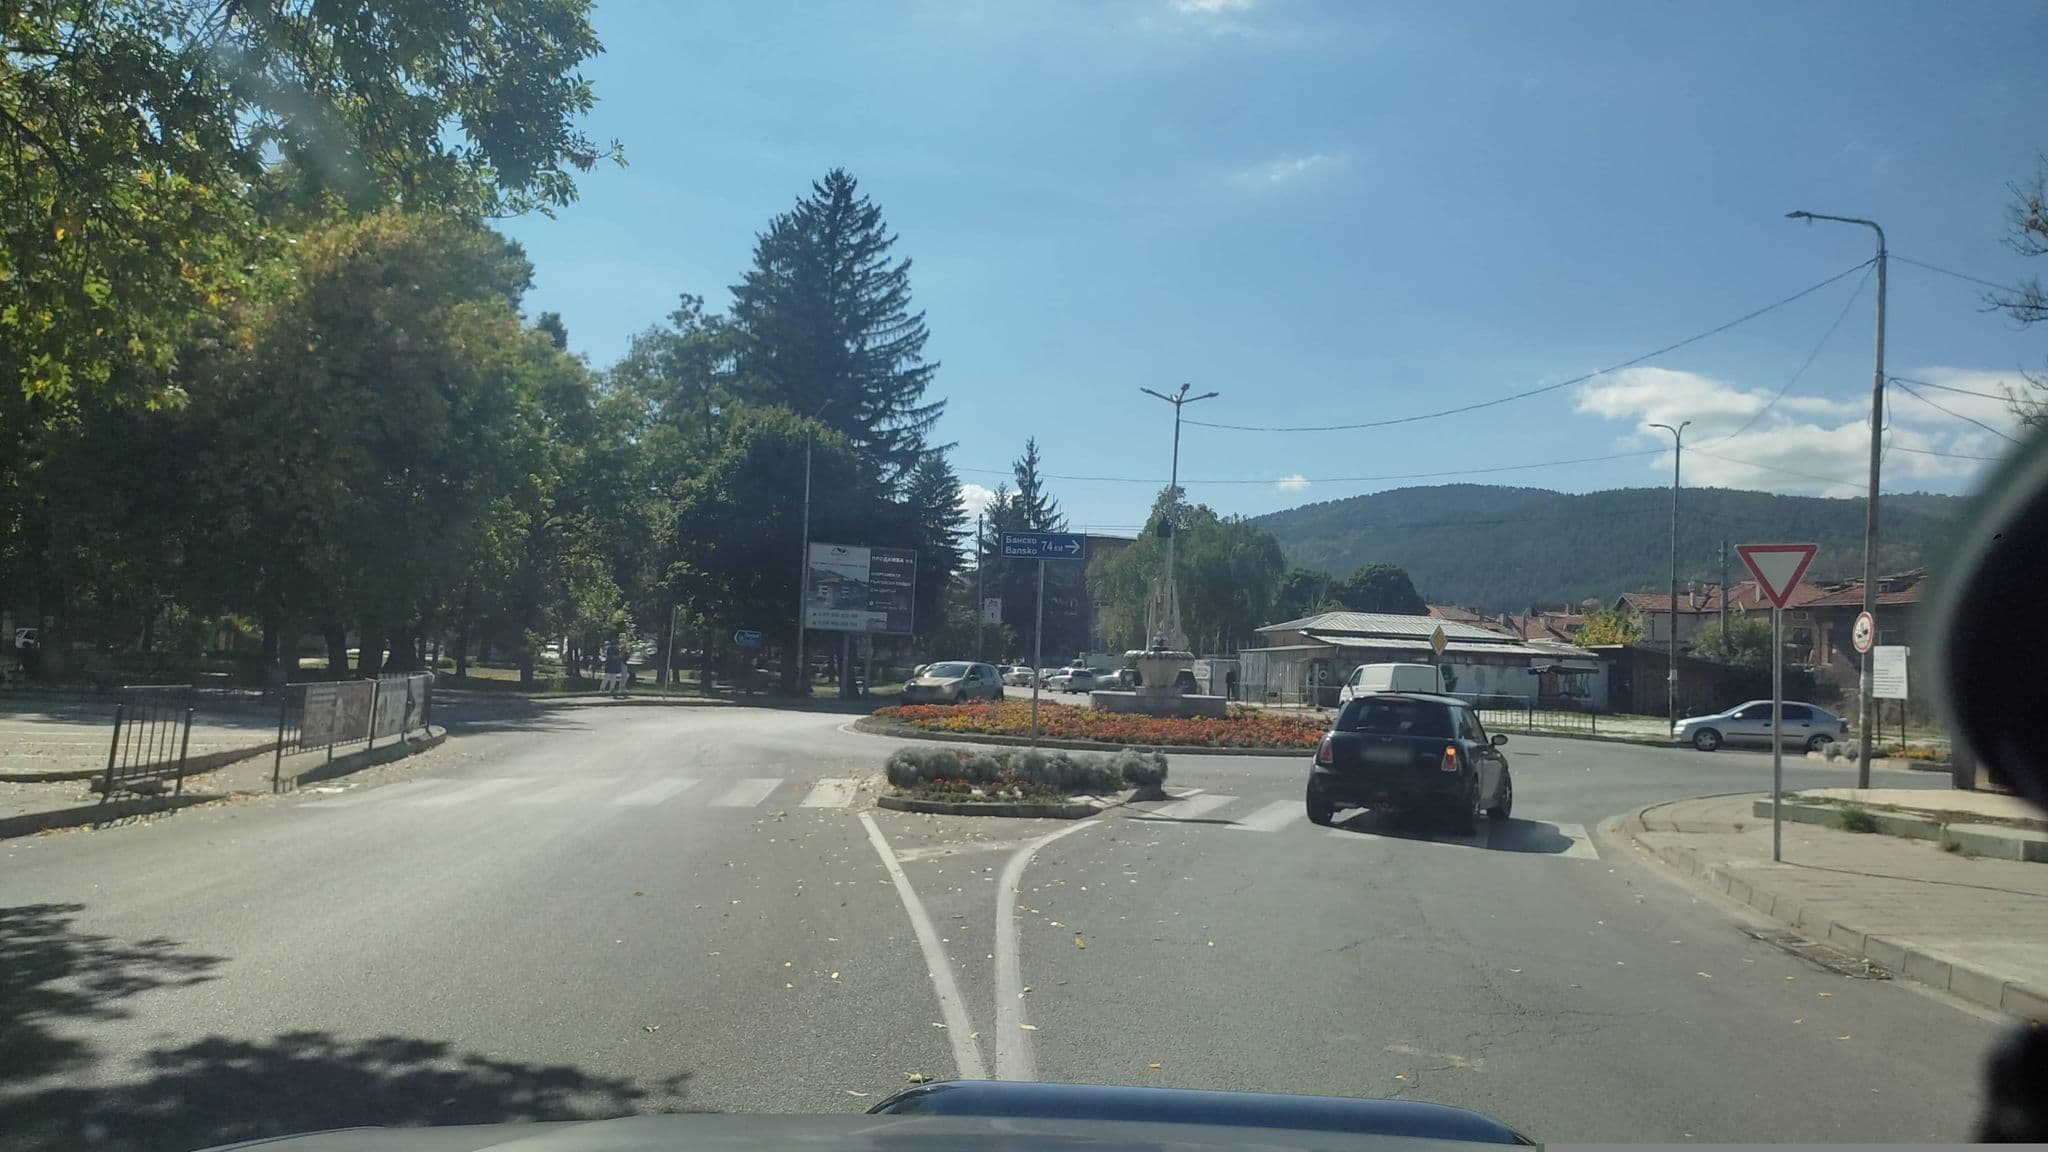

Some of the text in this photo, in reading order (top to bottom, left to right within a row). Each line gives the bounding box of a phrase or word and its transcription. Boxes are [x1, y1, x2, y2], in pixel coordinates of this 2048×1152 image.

[1005, 535, 1037, 544] Банско
[1005, 546, 1038, 555] Bansko
[1041, 541, 1053, 551] 74
